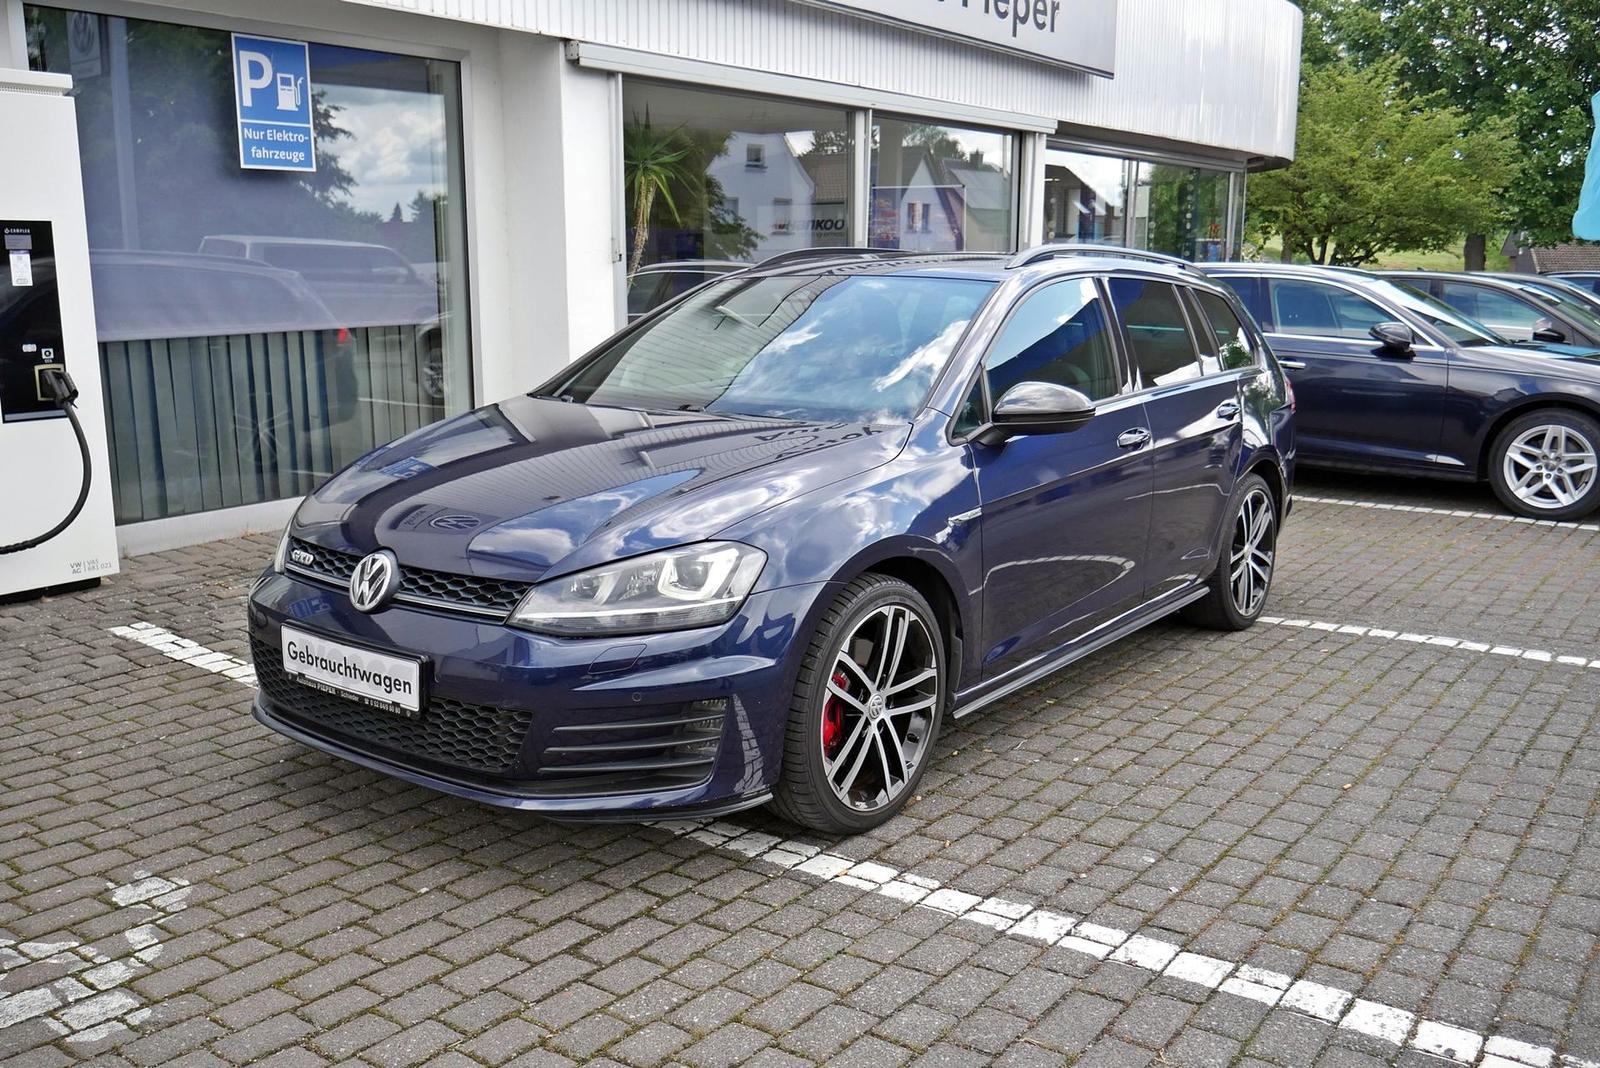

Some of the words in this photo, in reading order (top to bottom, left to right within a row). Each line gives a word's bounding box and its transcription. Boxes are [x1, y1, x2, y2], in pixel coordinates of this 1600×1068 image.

[961, 0, 1060, 38] eper
[238, 50, 274, 108] P
[244, 127, 265, 140] Nur
[267, 128, 309, 143] Elektro-
[250, 146, 306, 163] fahrzeuge
[287, 641, 412, 695] Gebrauchtwagen
